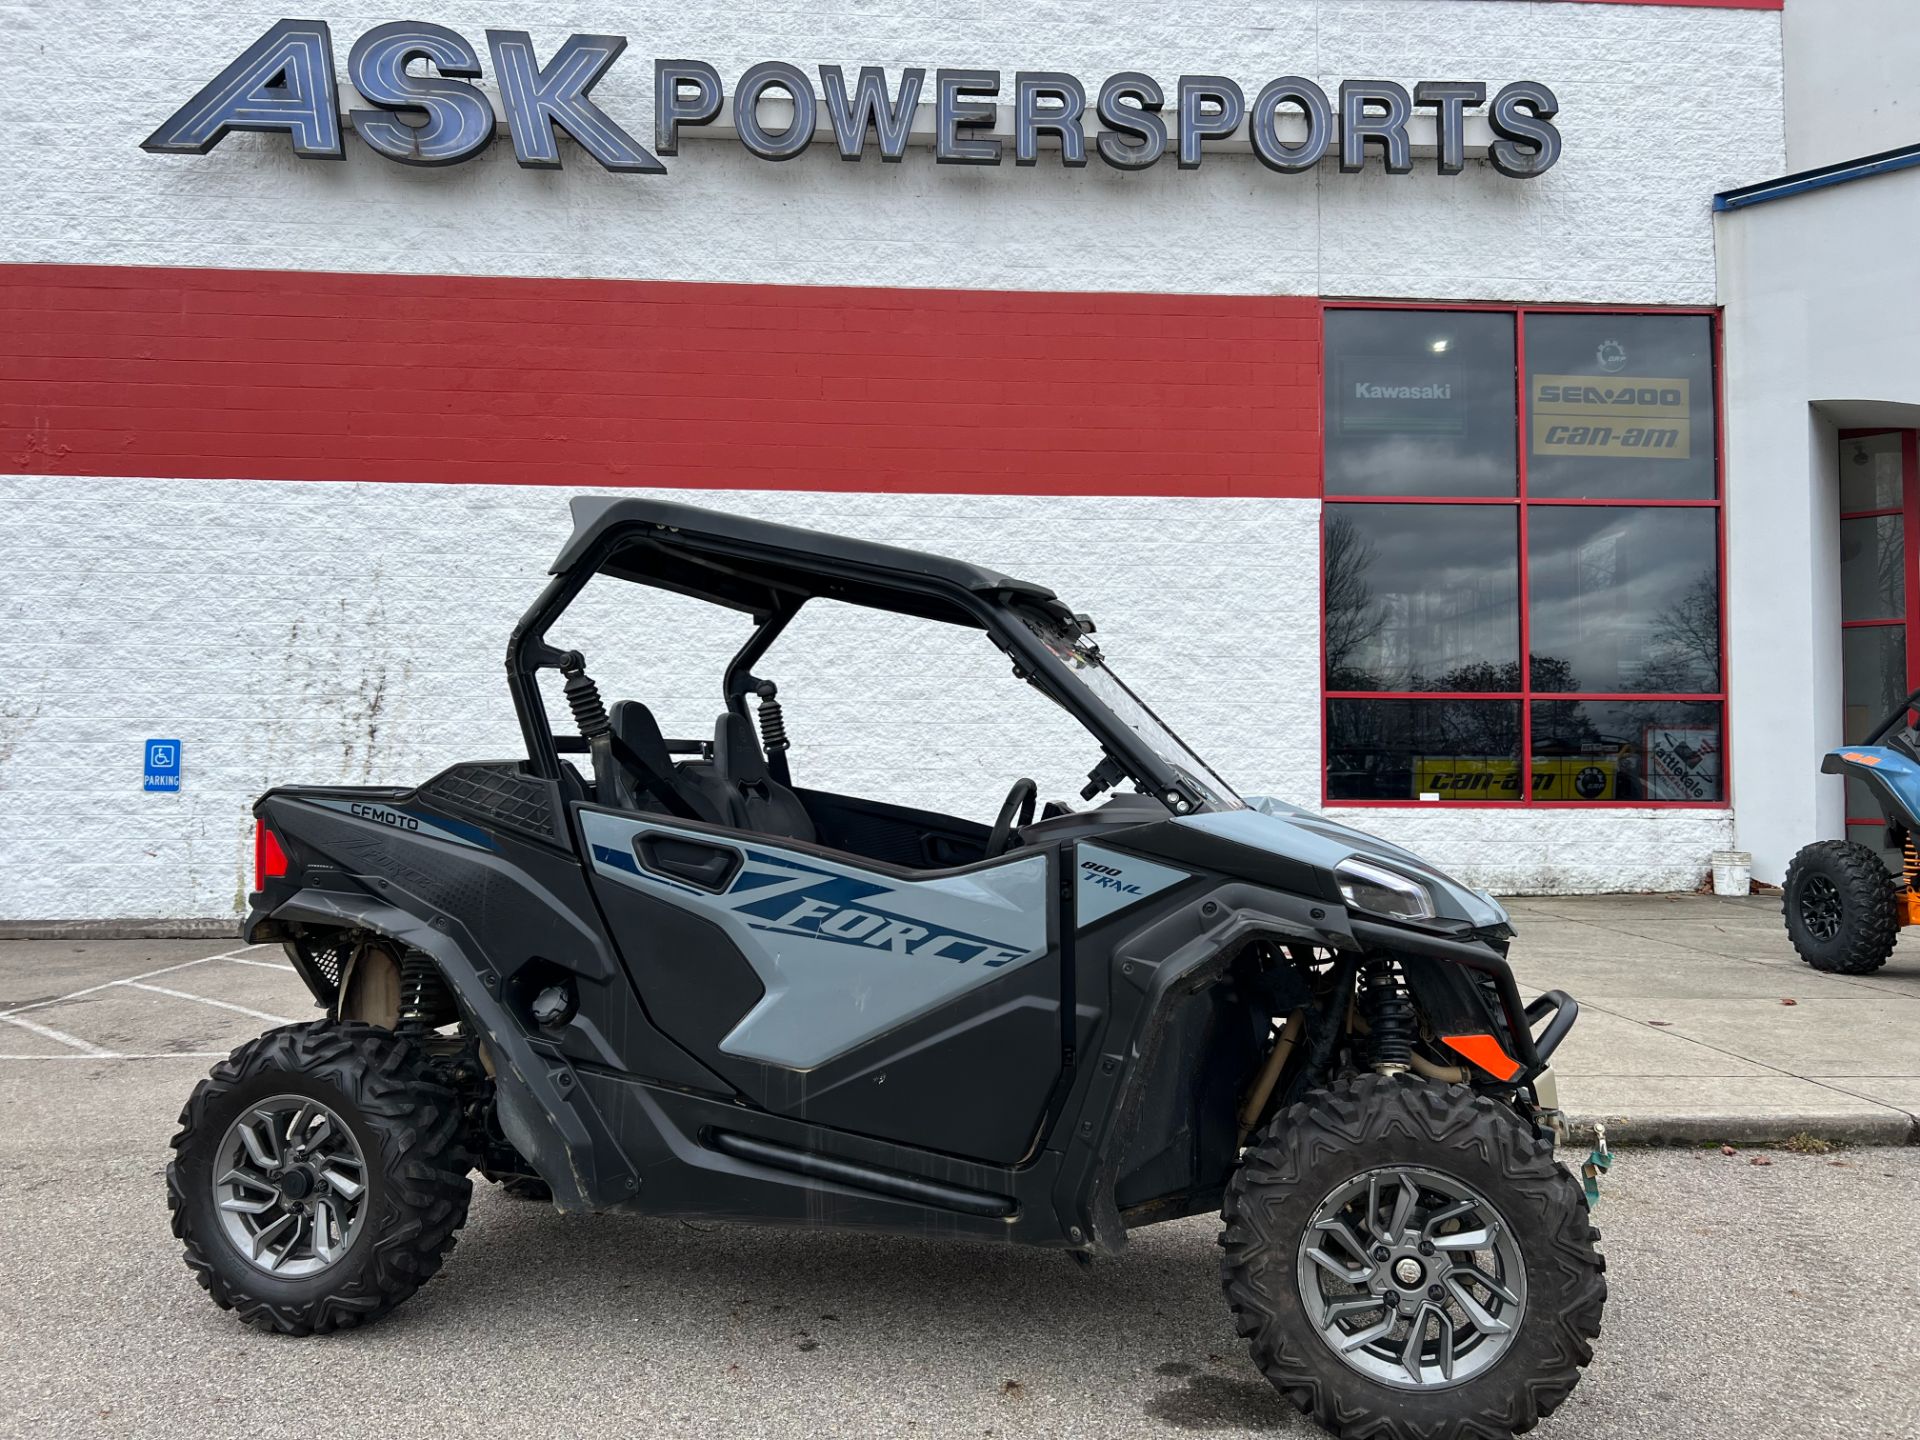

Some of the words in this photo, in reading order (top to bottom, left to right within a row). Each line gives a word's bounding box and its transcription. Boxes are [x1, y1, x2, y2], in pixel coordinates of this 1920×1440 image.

[138, 18, 668, 176] ASK
[655, 58, 1563, 179] POWERSPORTS
[1355, 382, 1452, 400] Kawasaki
[1545, 425, 1680, 449] can-am
[144, 775, 179, 786] PARKING
[350, 803, 419, 831] CFMOTO
[1080, 861, 1123, 877] 800
[1084, 871, 1143, 896] TRAIL
